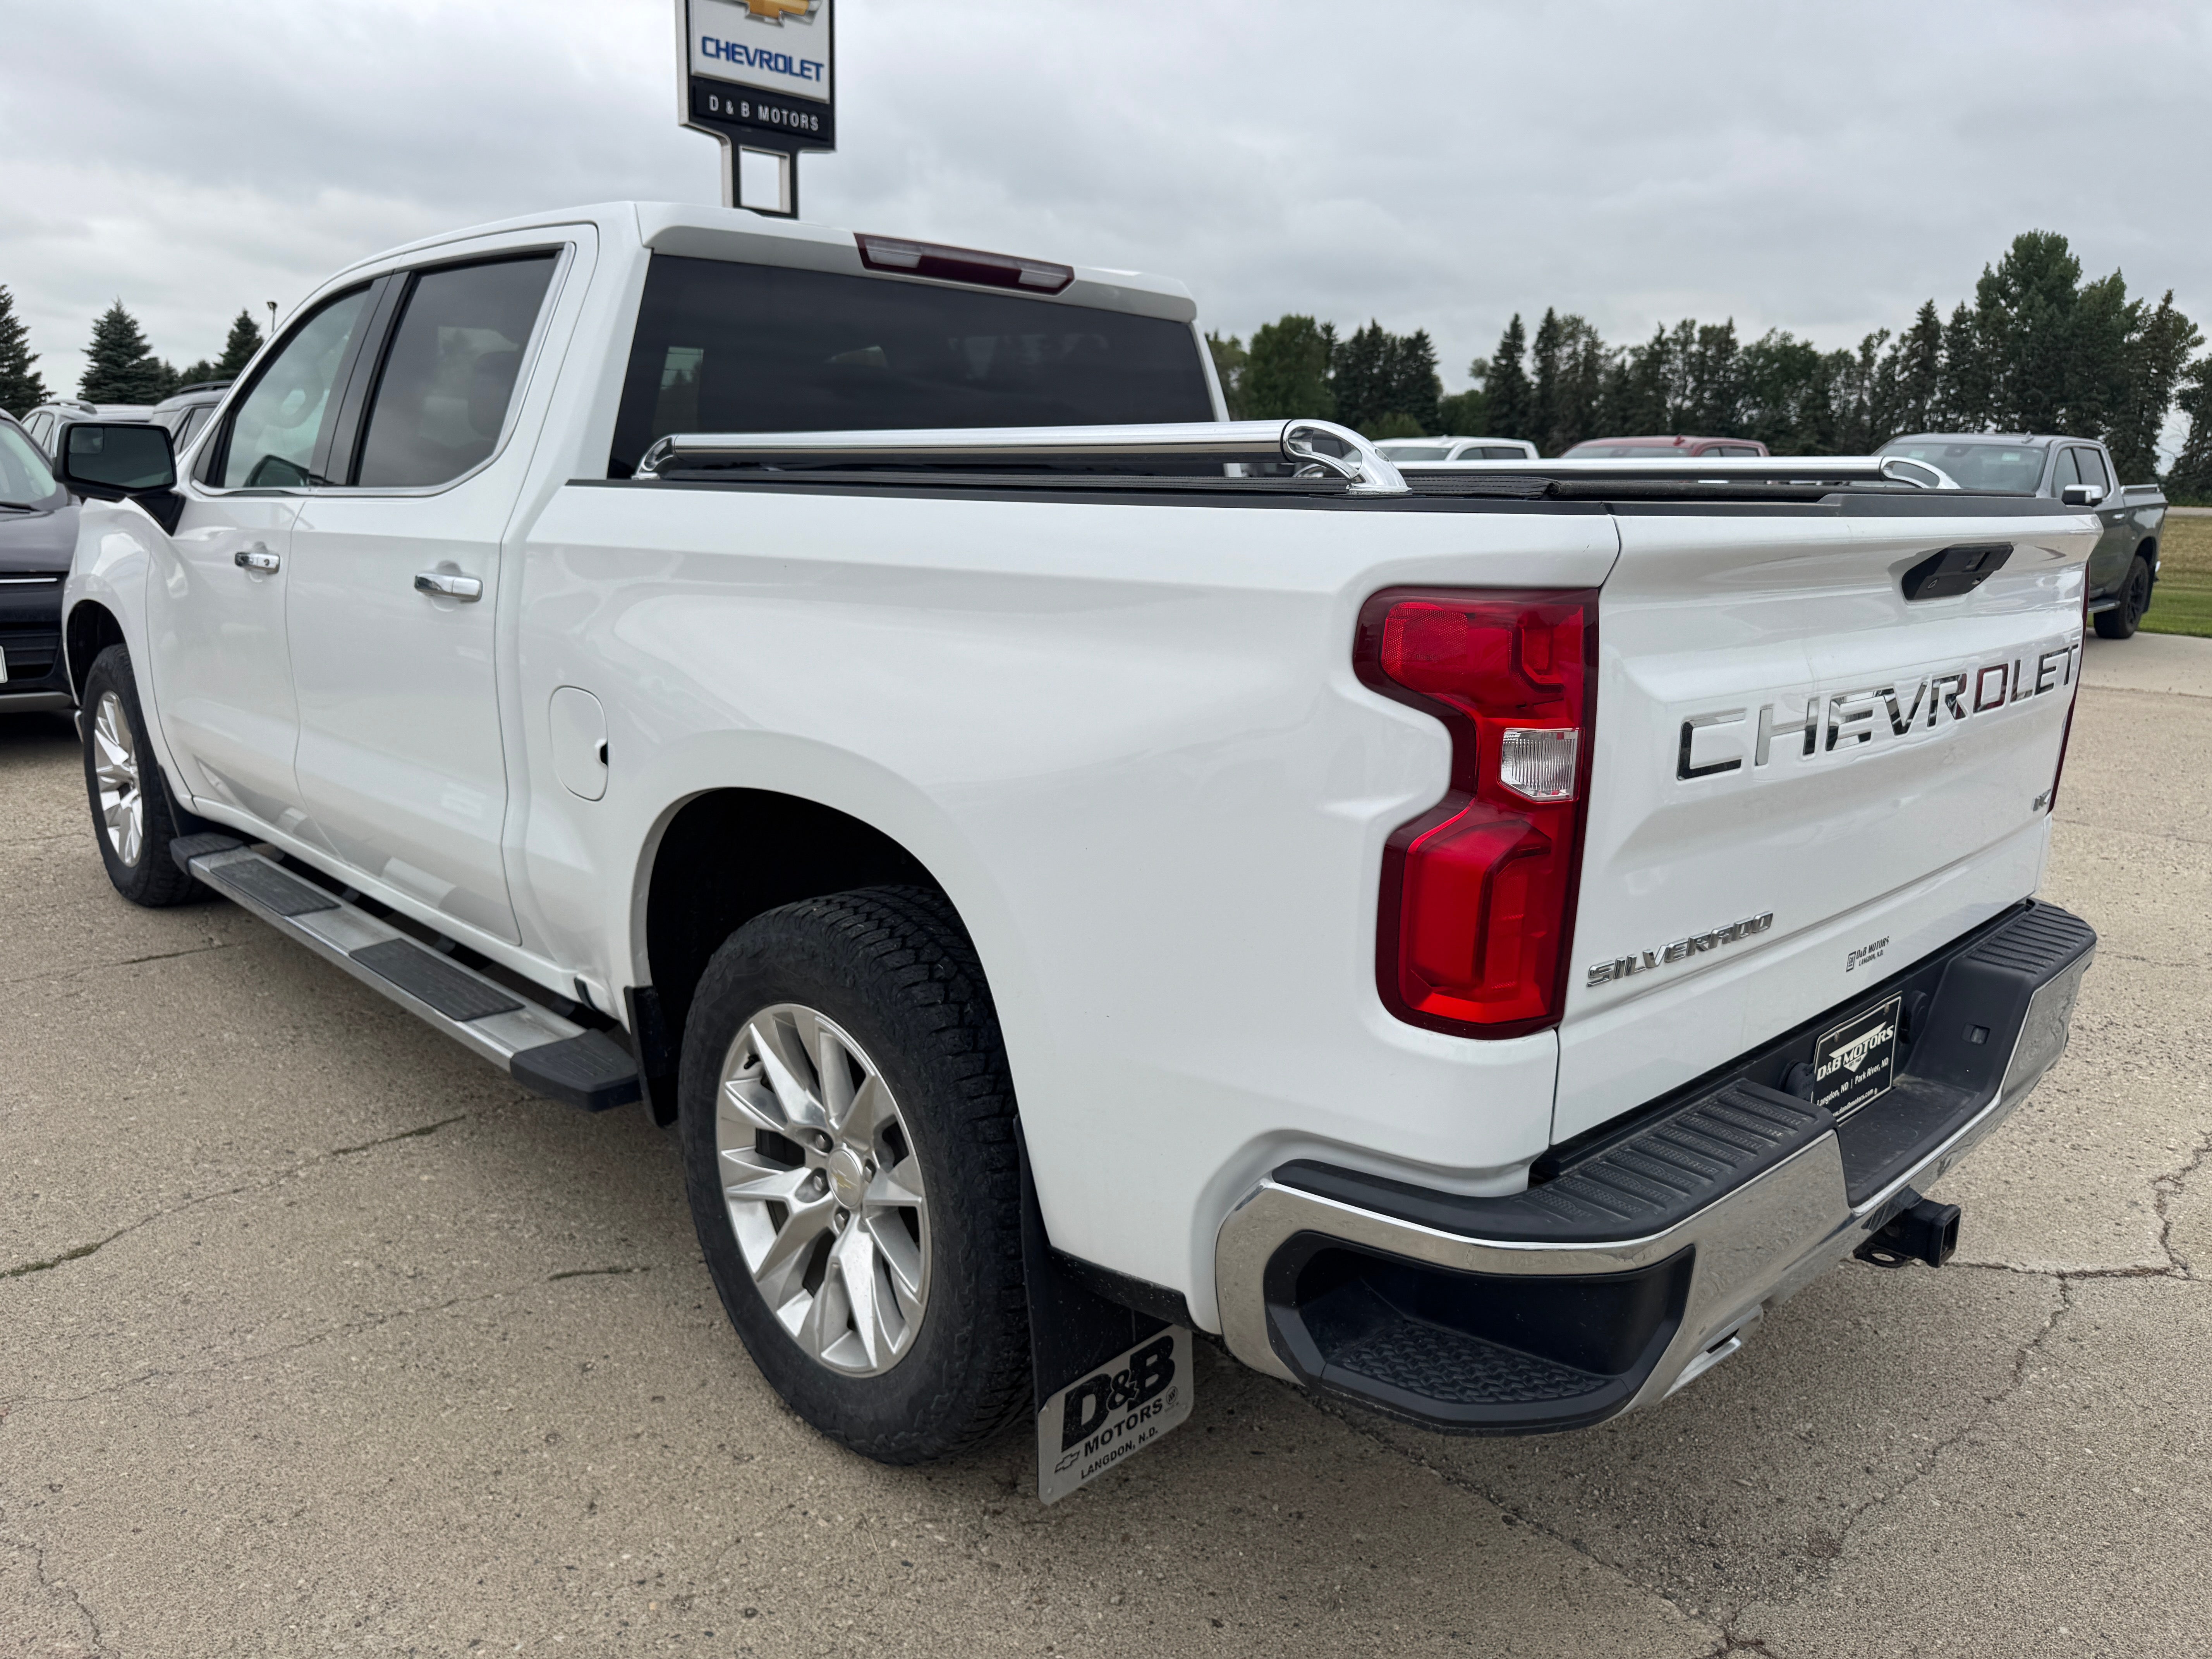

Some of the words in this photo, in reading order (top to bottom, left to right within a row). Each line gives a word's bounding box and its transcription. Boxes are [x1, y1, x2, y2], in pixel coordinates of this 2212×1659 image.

[702, 36, 824, 82] CHEVROLET
[709, 94, 719, 111] D
[726, 100, 734, 115] &
[741, 101, 750, 118] B
[757, 103, 819, 131] MOTORS
[1676, 644, 2078, 780] CHEVROLET
[1586, 910, 1773, 987] SILVERADO
[1868, 936, 1889, 953] MOTORS
[1817, 1056, 1841, 1082] D&B
[1843, 1025, 1894, 1065] MOTORS
[1817, 1089, 1840, 1106] Langdon,
[1841, 1082, 1849, 1093] ND
[1855, 1071, 1866, 1084] Park
[1867, 1064, 1881, 1077] River,
[1881, 1057, 1889, 1068] ND
[1061, 1335, 1175, 1453] D&B
[1080, 1443, 1136, 1479] LANGDON,
[1139, 1426, 1158, 1442] N.D.
[1084, 1398, 1163, 1457] MOTORS
